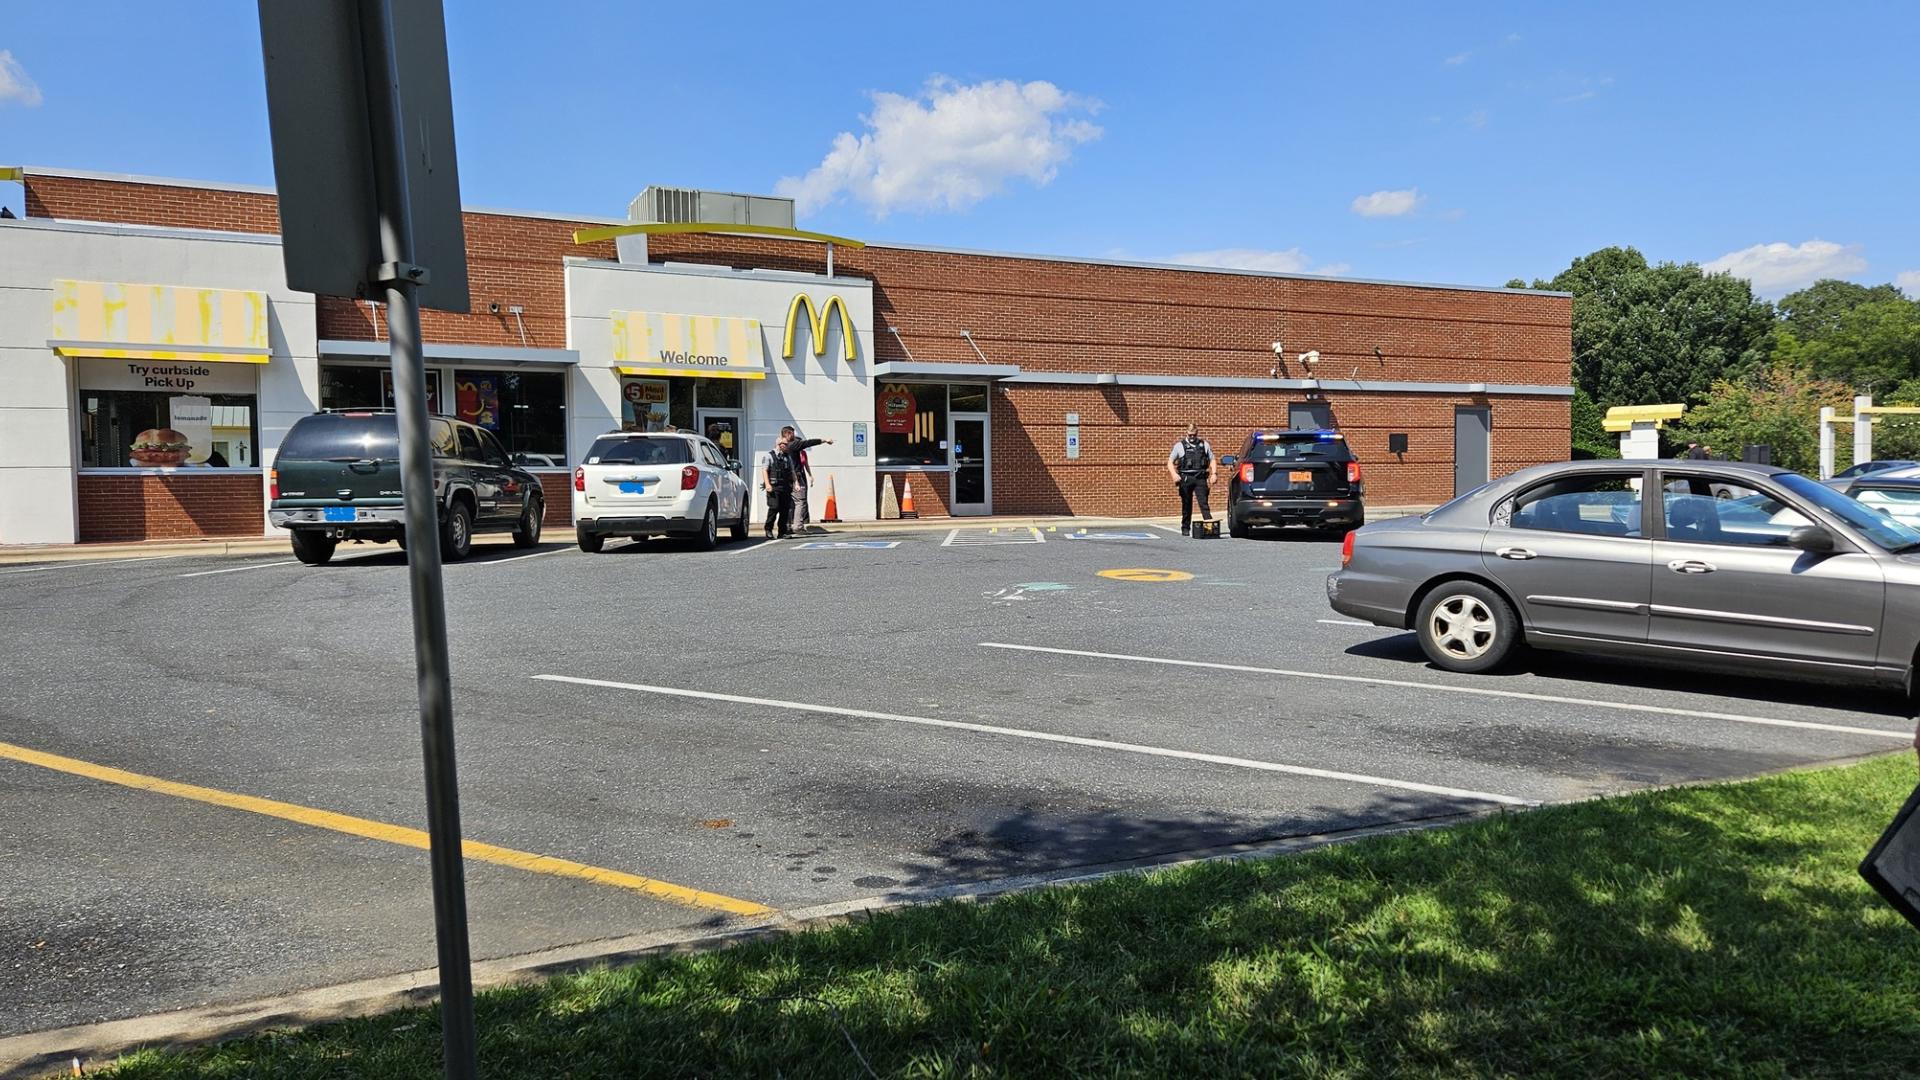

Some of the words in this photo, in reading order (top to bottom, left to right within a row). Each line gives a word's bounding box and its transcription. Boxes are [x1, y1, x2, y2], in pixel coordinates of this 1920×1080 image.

[660, 350, 728, 366] Welcome
[128, 364, 149, 376] Try
[152, 365, 210, 376] curbside
[145, 377, 173, 387] Pick
[176, 378, 194, 390] Up
